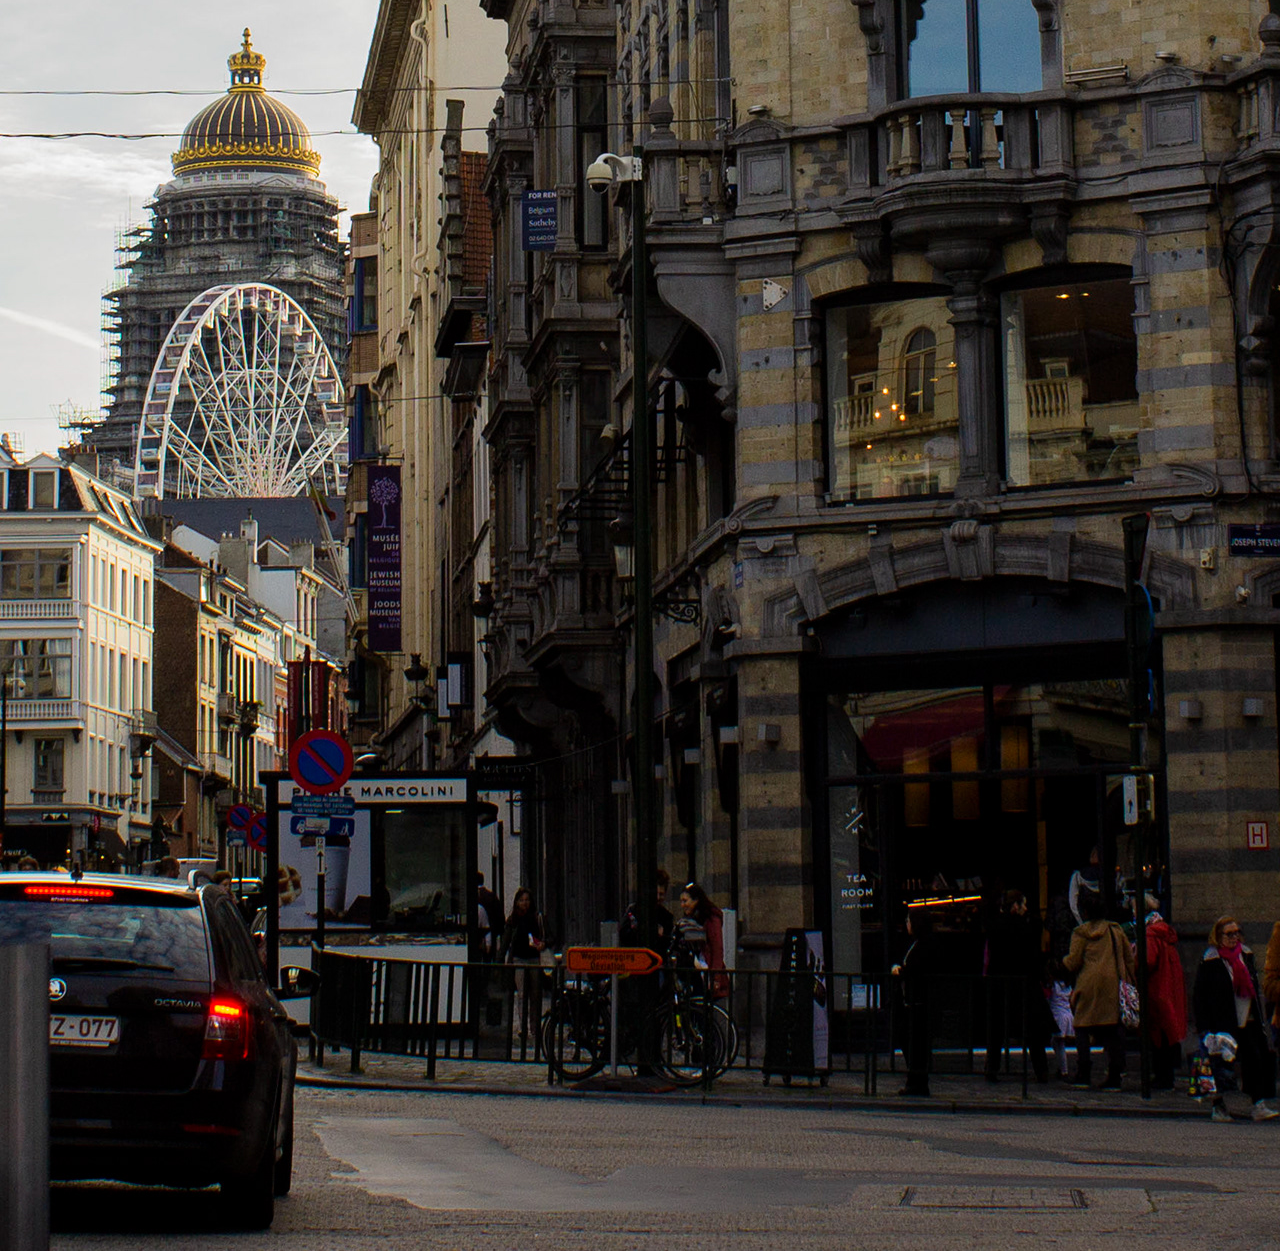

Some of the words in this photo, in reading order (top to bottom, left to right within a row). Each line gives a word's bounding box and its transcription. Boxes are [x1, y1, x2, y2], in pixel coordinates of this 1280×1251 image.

[528, 218, 556, 227] Sotheby
[372, 534, 400, 542] MUSÉE
[1230, 538, 1256, 547] JOSEPH
[383, 543, 400, 551] JUIF
[369, 571, 400, 579] JEWISH
[369, 579, 400, 587] MUSEUM
[374, 600, 400, 609] JOODS
[369, 609, 400, 617] MUSEUM
[361, 786, 454, 797] MARCOLINI
[1252, 826, 1263, 844] H
[846, 874, 867, 883] TEA
[841, 888, 873, 897] ROOM
[154, 998, 202, 1009] OCTAVIA
